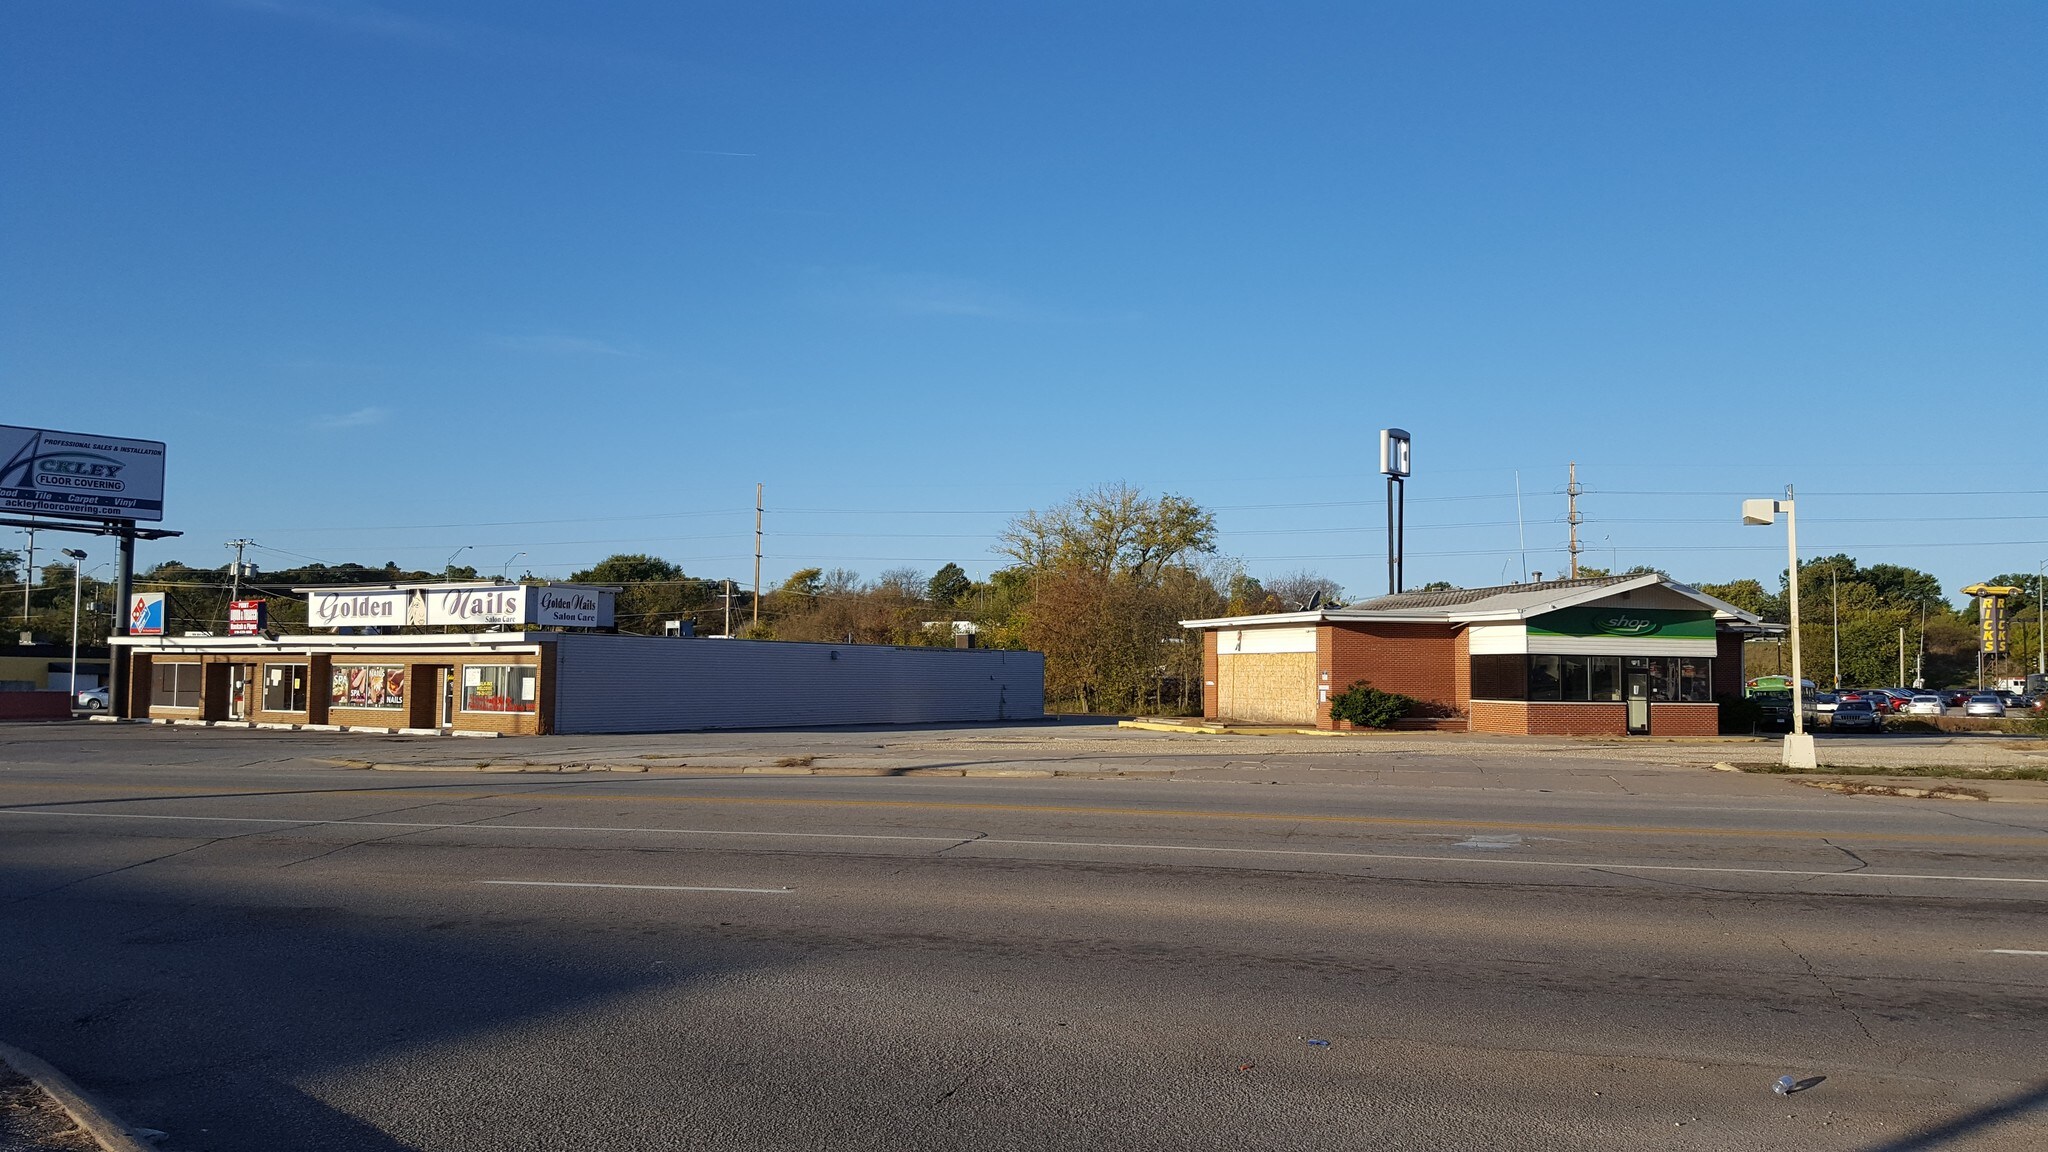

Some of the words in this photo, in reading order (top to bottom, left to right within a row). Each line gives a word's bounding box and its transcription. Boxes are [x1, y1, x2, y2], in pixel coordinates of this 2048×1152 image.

[44, 438, 91, 449] PROFESSIONAL
[92, 443, 112, 451] SALES
[120, 446, 162, 456] INSTALLATION
[40, 475, 71, 486] FLOOR
[74, 478, 121, 490] COVERING
[0, 488, 18, 497] ood
[35, 491, 52, 500] Tile
[68, 494, 98, 505] Carpet
[114, 498, 137, 507] Vinyl
[5, 499, 121, 515] ackleyfloorcovering.com
[317, 592, 393, 625] Golden
[442, 588, 517, 620] Nails
[541, 592, 571, 611] Golden
[571, 594, 596, 610] Nails
[485, 615, 502, 623] Salon
[553, 611, 576, 620] Salon
[577, 613, 596, 621] Care
[1608, 615, 1650, 631] shop
[1982, 598, 1994, 652] RICKS
[1997, 598, 2006, 652] RICKS
[386, 696, 403, 704] NAILS
